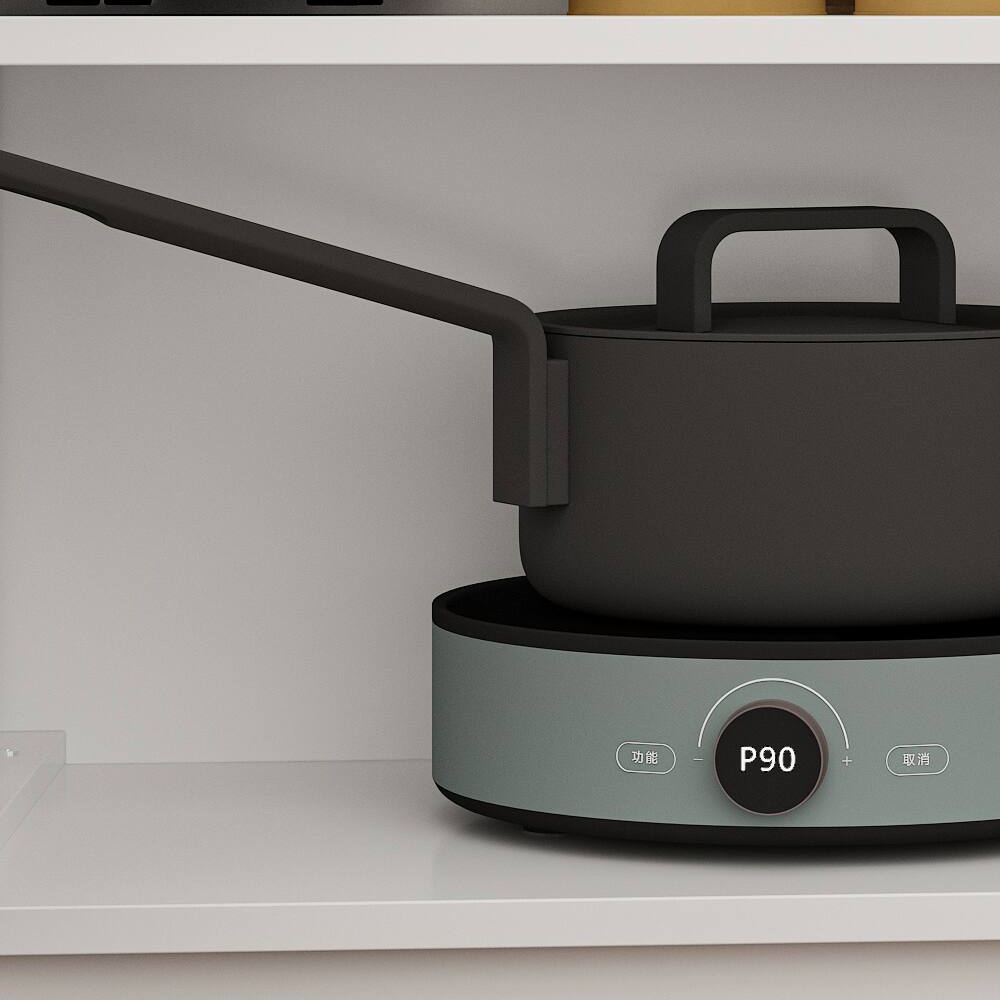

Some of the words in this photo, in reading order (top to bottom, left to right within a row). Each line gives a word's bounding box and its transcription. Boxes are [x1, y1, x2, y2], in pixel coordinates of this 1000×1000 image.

[631, 750, 659, 765] 功能
[740, 746, 797, 772] P90
[902, 752, 931, 766] 取消
